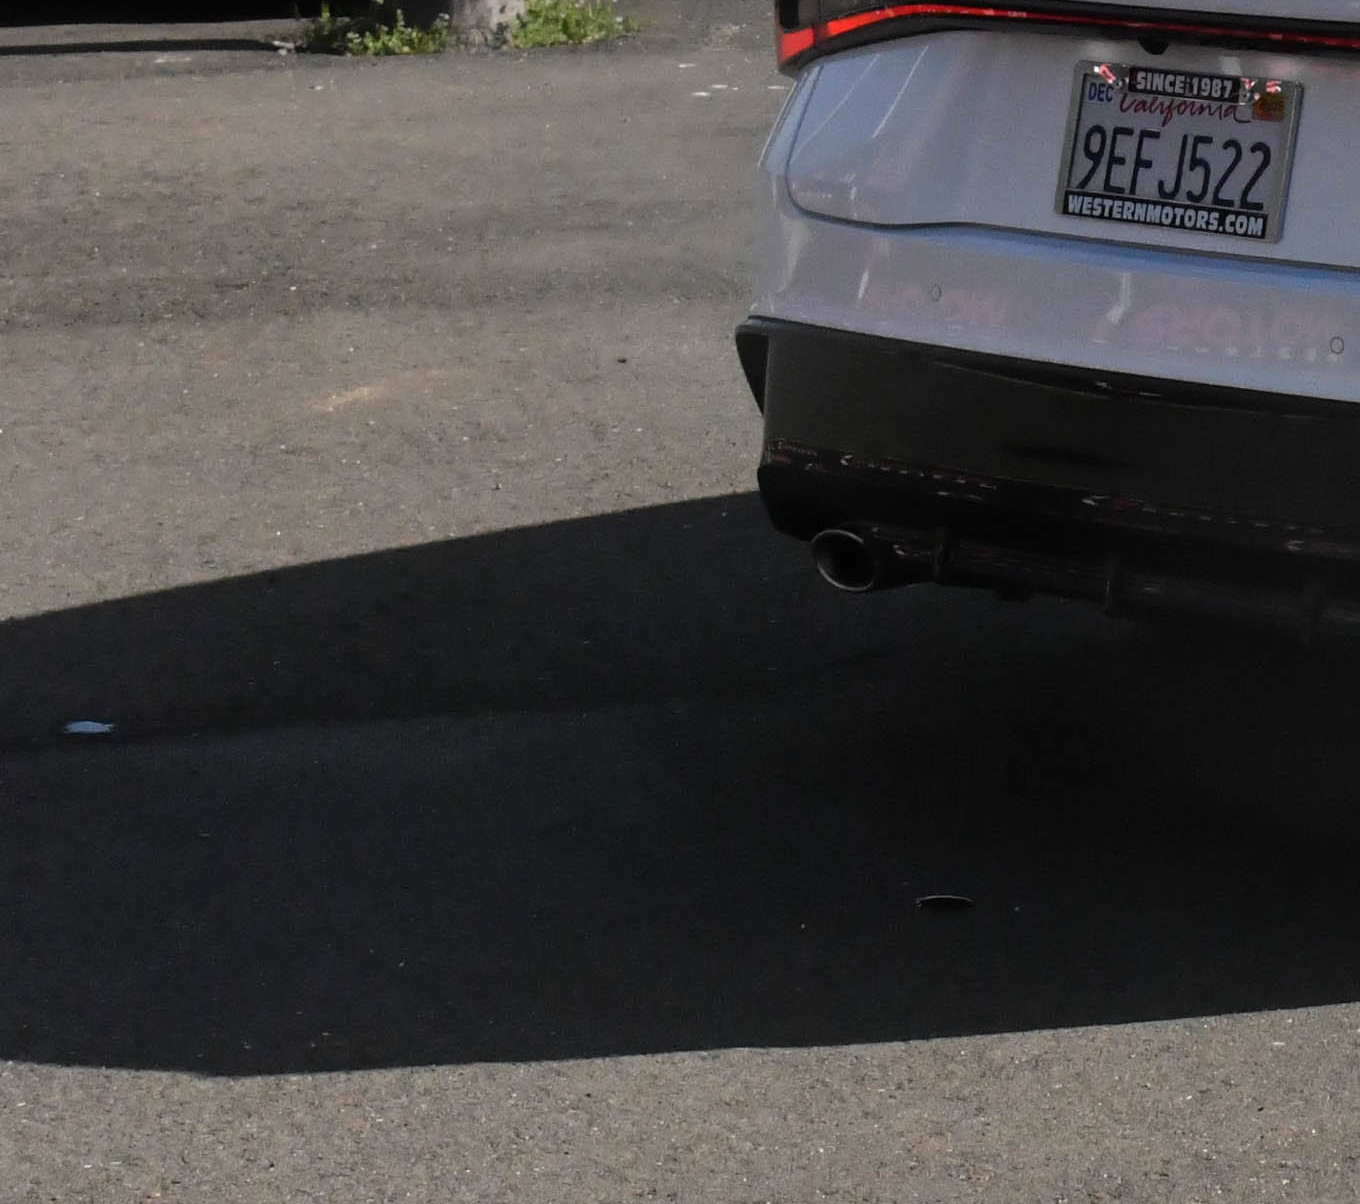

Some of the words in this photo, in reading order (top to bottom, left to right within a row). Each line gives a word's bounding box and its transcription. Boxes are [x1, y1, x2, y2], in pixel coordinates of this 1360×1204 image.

[1087, 82, 1113, 102] DEC
[1136, 71, 1186, 94] SINCE
[1191, 77, 1233, 102] 1987
[1119, 92, 1251, 127] California
[1075, 124, 1272, 211] 9EFJ522
[1067, 195, 1265, 237] WESTERNMOTORS.COM
